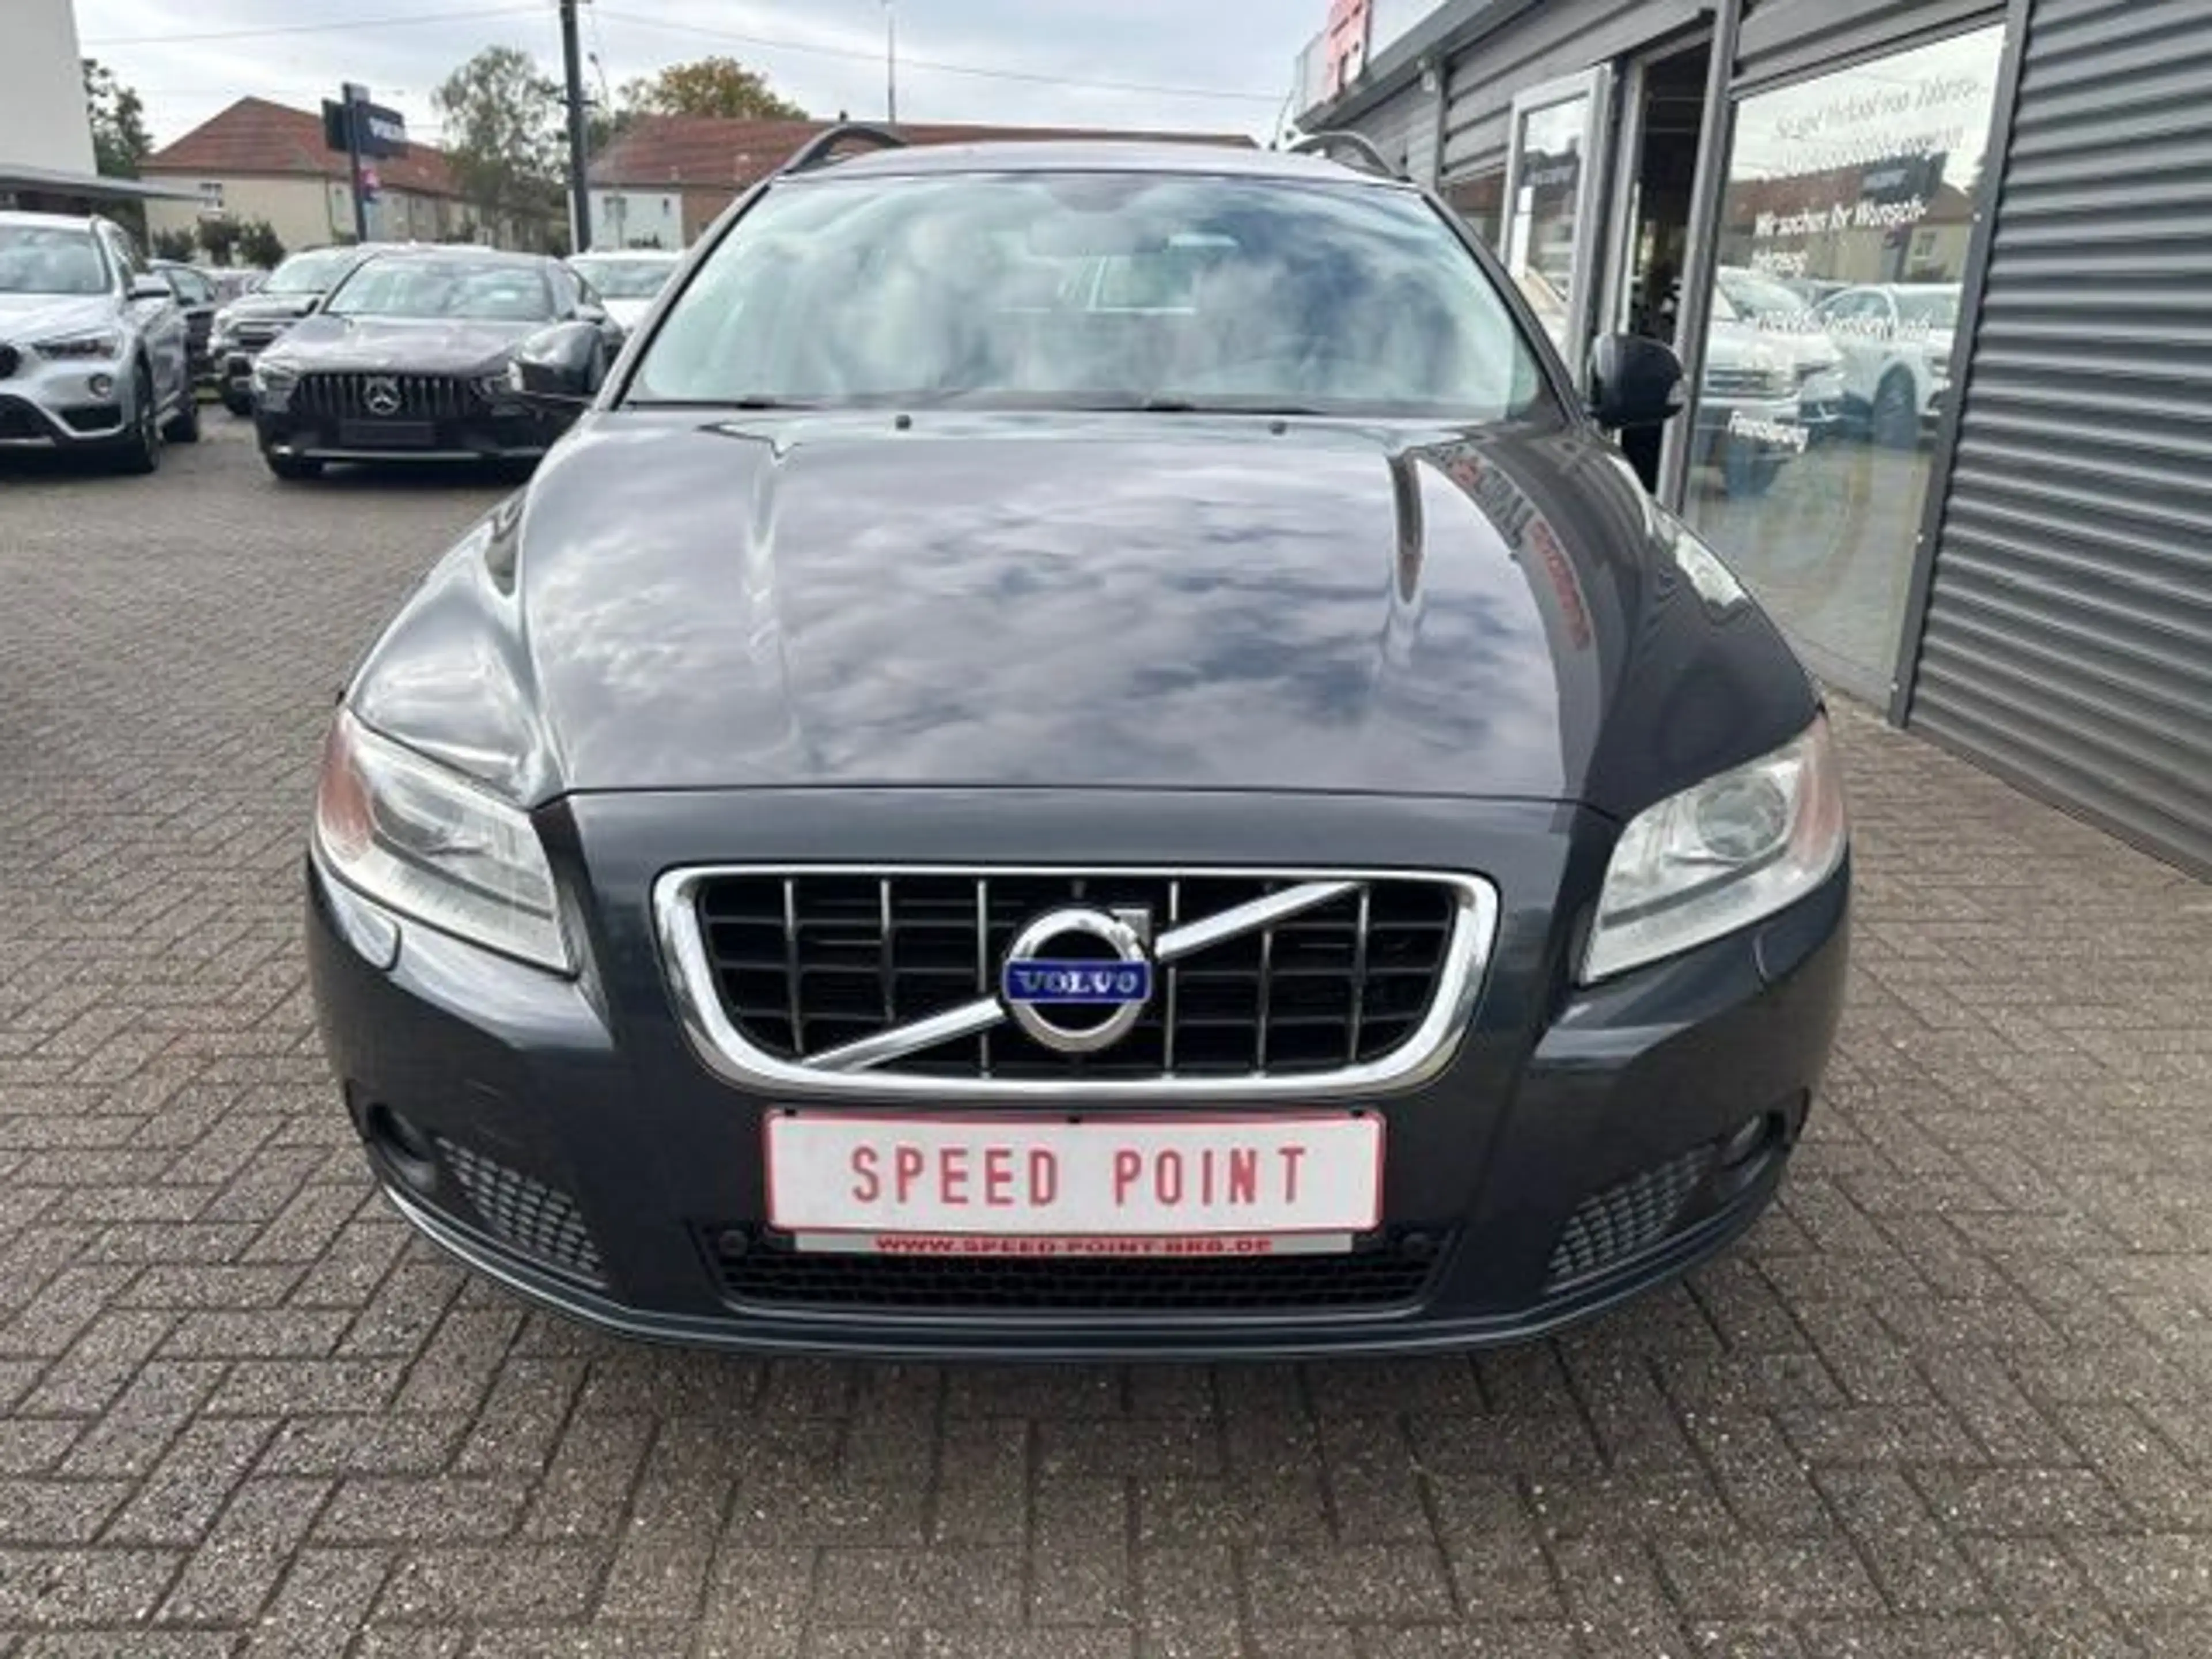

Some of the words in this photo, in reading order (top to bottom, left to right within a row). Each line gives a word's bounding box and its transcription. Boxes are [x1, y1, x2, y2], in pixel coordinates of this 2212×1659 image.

[1013, 970, 1139, 994] VOLVO
[851, 1146, 1056, 1207] SPEED
[1113, 1146, 1307, 1207] POINT
